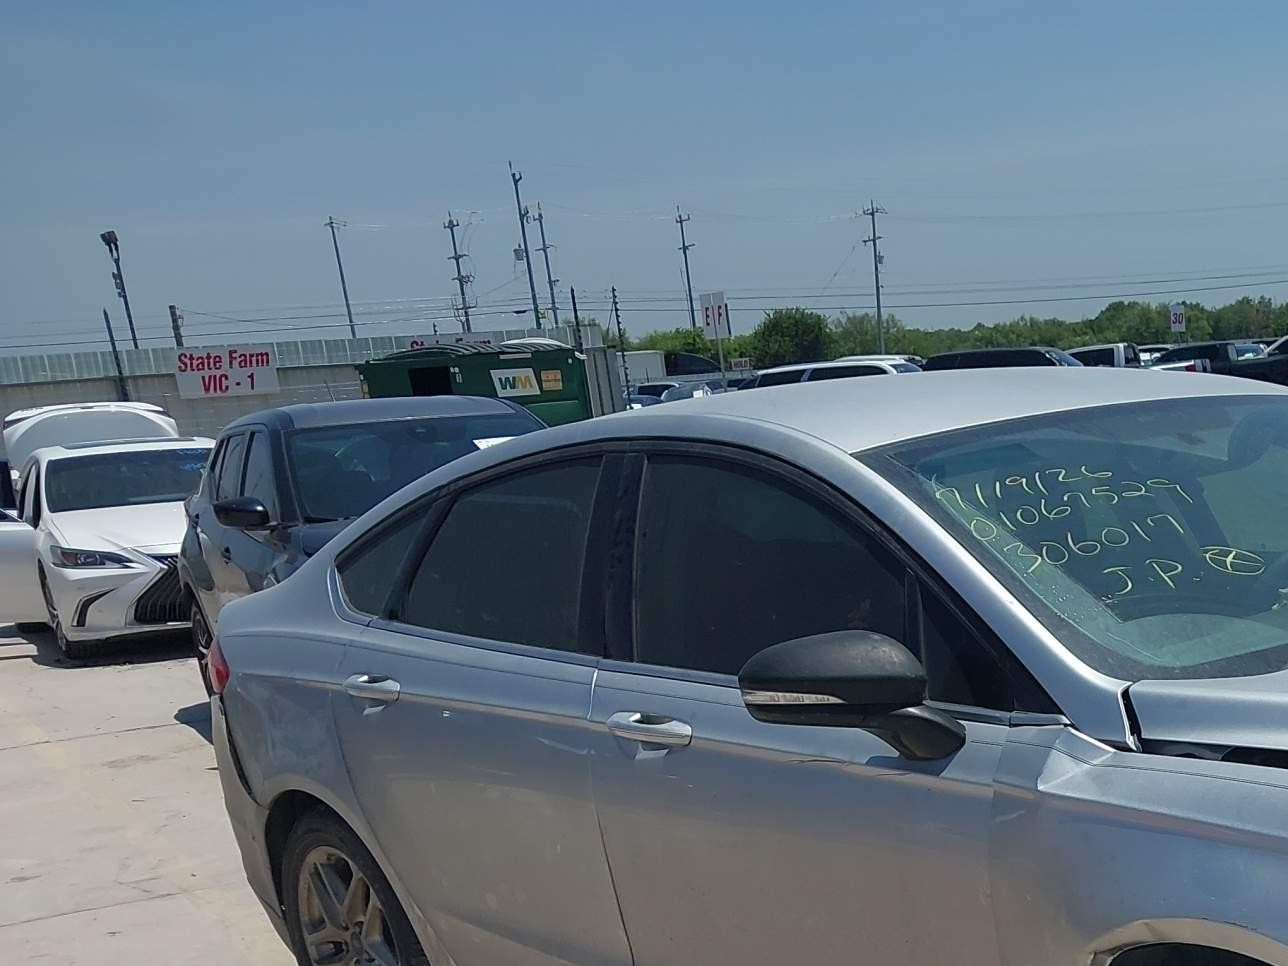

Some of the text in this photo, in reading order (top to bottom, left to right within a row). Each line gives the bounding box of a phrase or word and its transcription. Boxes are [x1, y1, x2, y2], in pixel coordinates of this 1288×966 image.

[705, 305, 723, 326] E F
[1172, 312, 1184, 325] 30
[178, 349, 270, 373] State Farm
[201, 373, 229, 394] VIC
[247, 372, 255, 390] 1
[498, 375, 533, 391] WM
[971, 479, 1193, 540] 01067529
[1003, 513, 1185, 575] 306017
